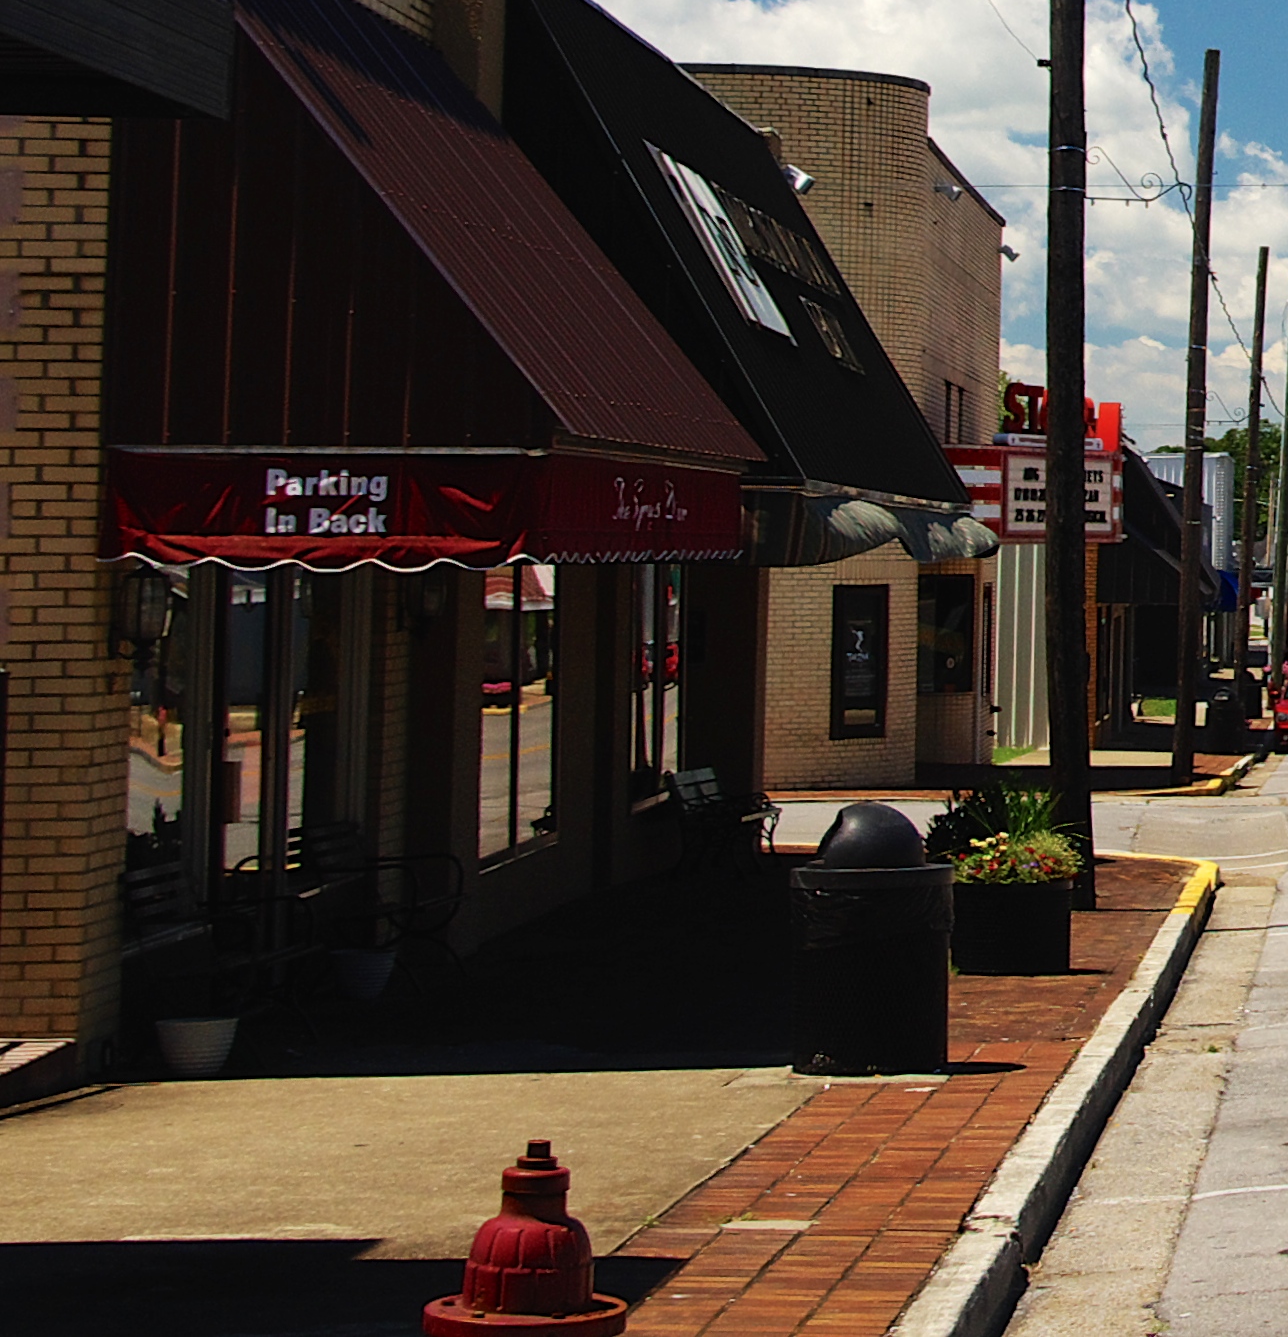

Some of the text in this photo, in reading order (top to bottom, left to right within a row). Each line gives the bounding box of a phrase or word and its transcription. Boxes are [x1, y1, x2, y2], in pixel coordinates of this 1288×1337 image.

[266, 468, 389, 501] Parking
[265, 507, 388, 534] In Back
